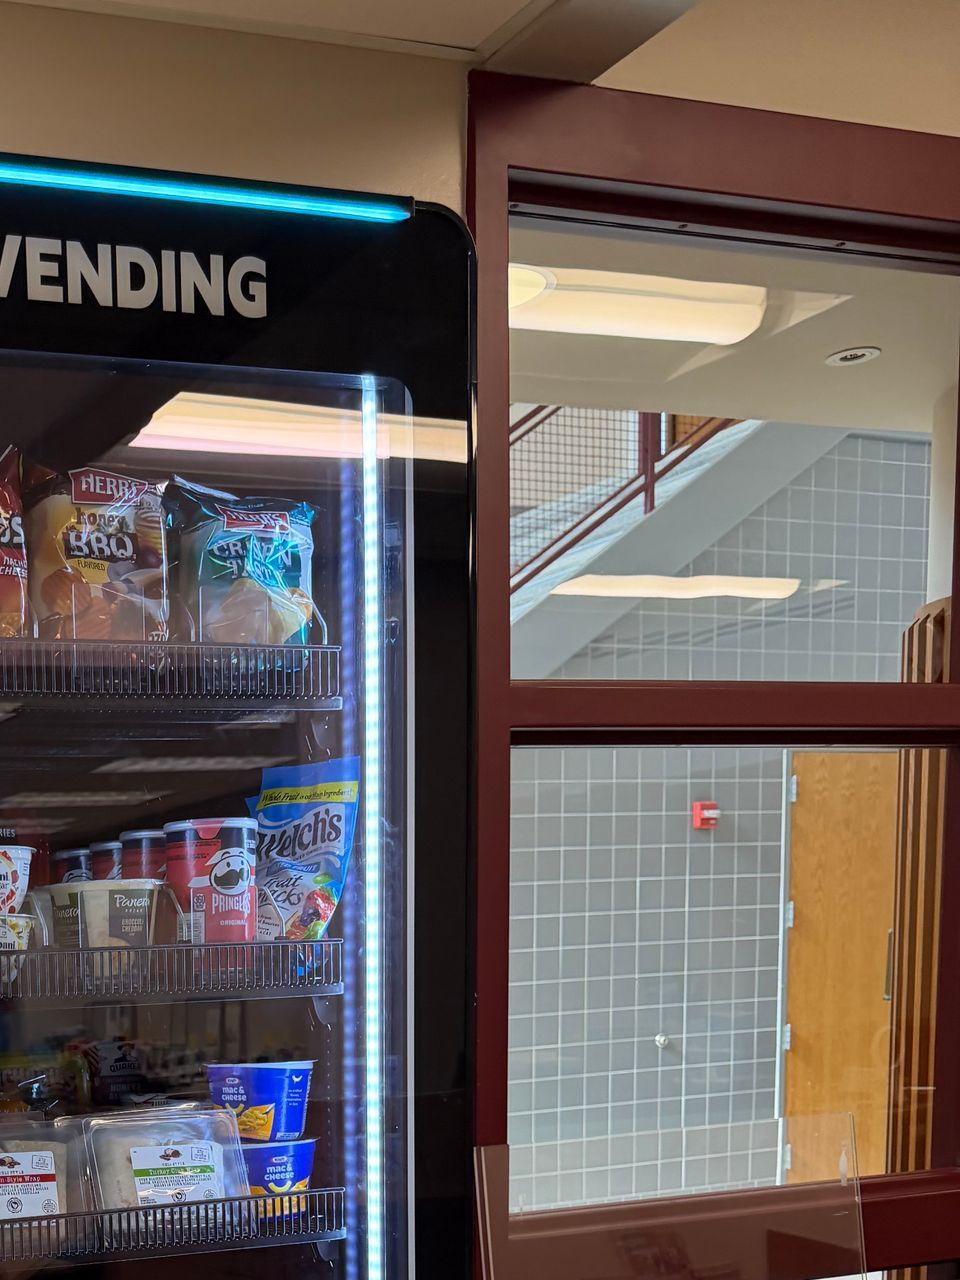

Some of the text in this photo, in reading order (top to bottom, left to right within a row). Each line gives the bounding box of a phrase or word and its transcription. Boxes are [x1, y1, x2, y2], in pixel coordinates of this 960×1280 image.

[68, 530, 134, 559] BBQ
[256, 808, 342, 862] Welch's
[264, 874, 303, 889] Fruit
[114, 894, 150, 908] Panera
[211, 893, 251, 915] PRINGLES
[266, 1165, 285, 1174] mac
